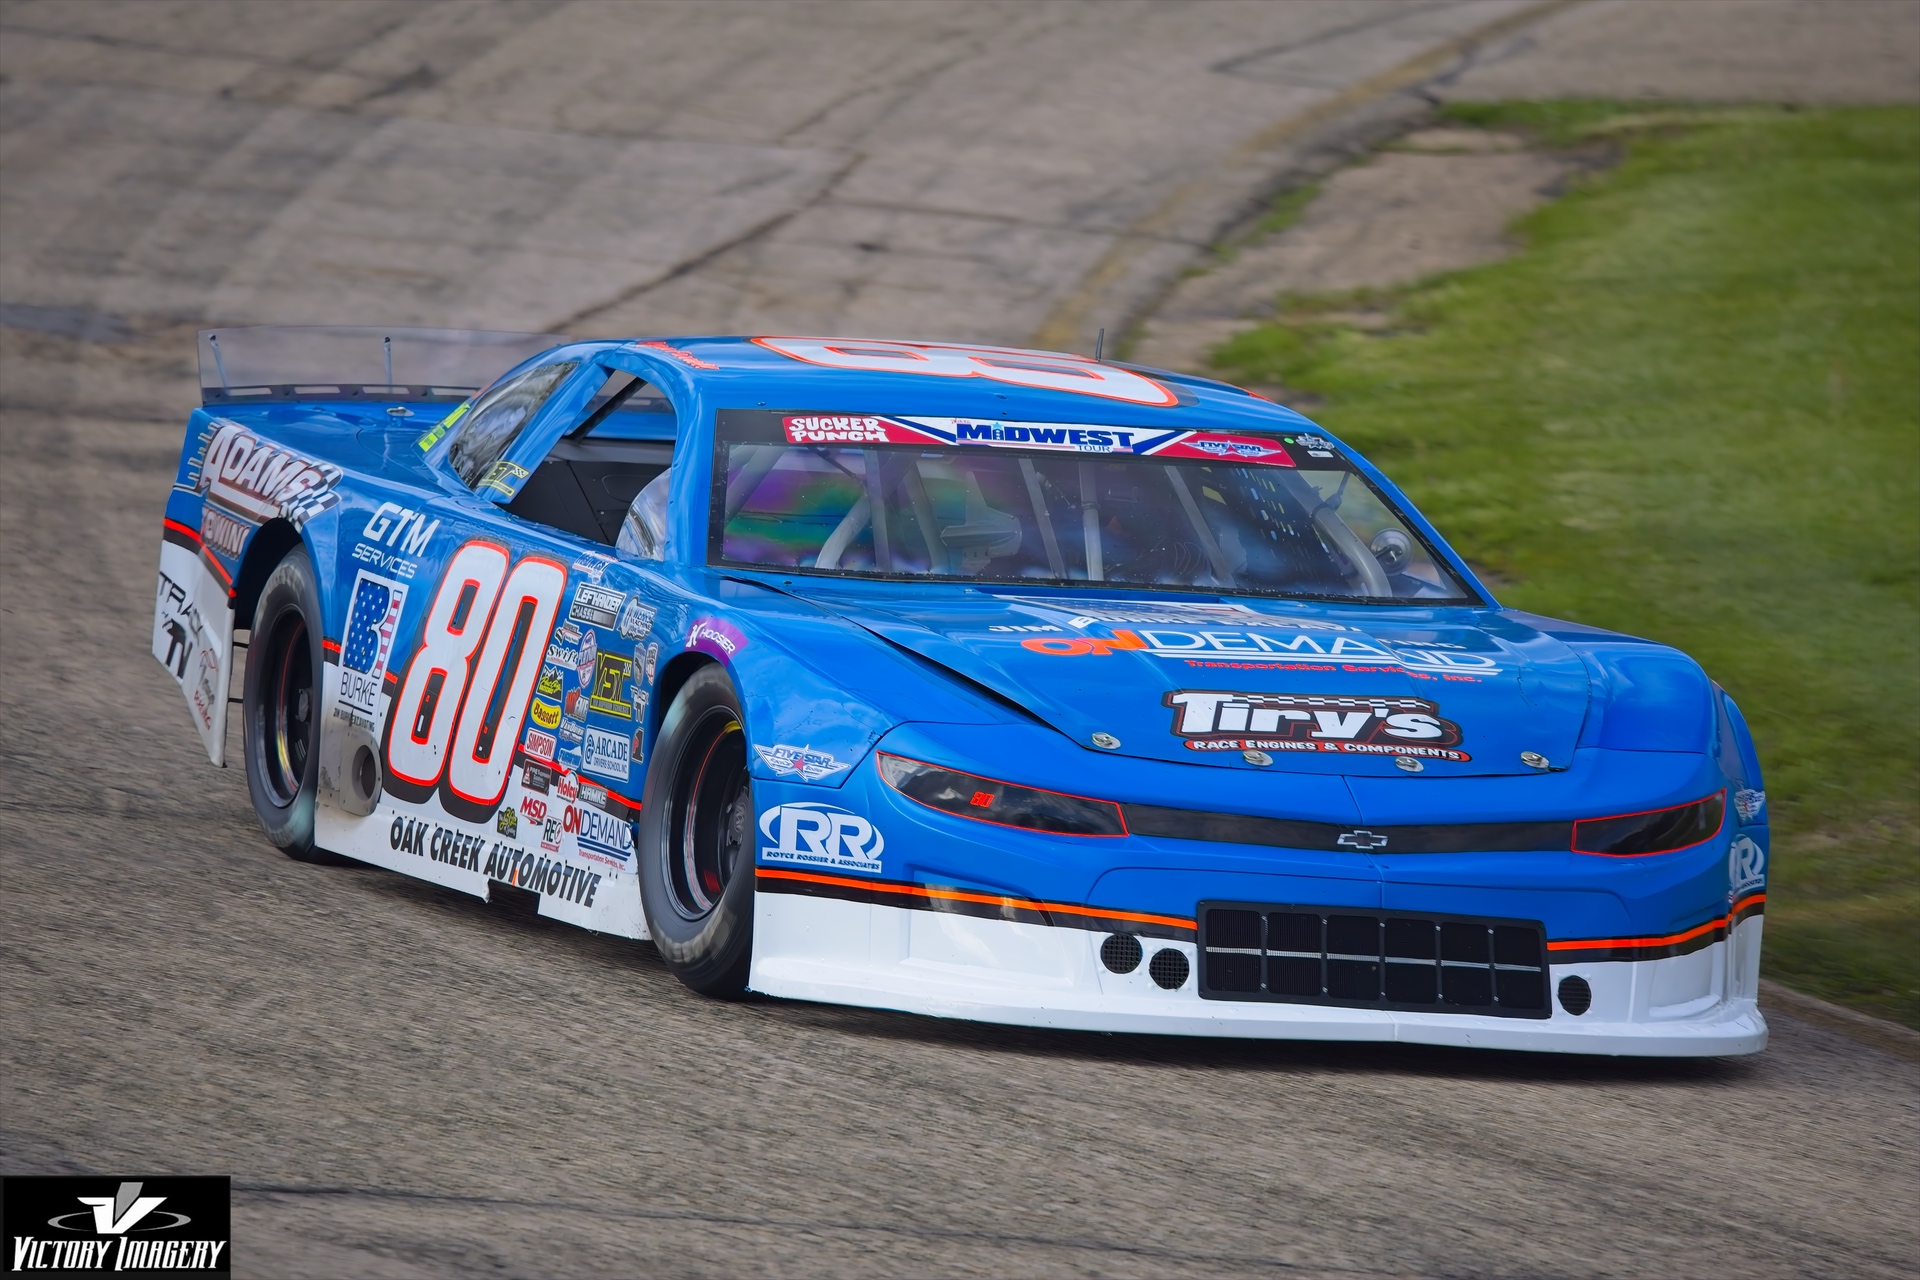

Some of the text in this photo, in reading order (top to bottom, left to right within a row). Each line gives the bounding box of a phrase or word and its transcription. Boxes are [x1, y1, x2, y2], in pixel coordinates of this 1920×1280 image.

[789, 417, 886, 432] SUCKER
[791, 430, 890, 443] PUNCH
[957, 423, 1134, 448] MIDWEST
[1078, 444, 1111, 453] TOUR
[201, 425, 325, 503] ADAMS
[363, 501, 440, 557] GTM
[352, 543, 418, 579] SERVICES
[700, 628, 736, 654] HOOSIER
[1021, 629, 1496, 668] ONDEMAND
[547, 643, 578, 667] Swift
[1184, 660, 1336, 671] Transportation
[388, 538, 568, 807] 80
[341, 671, 378, 707] BURKE
[533, 702, 560, 726] Bassett
[1173, 693, 1443, 738] Tiry's
[526, 732, 554, 757] SIMPSON
[595, 736, 628, 762] ARCADE
[1193, 740, 1461, 759] RACE ENGINES & COMPONENTS
[772, 748, 802, 760] FIVE
[804, 753, 832, 768] STAR
[520, 796, 547, 819] MSD
[580, 784, 607, 806] HAMKE
[563, 805, 632, 851] ONDEMAND
[390, 816, 602, 908] OAK CREEK AUTOMOTIVE
[766, 851, 794, 859] ROYCE
[797, 854, 828, 863] ROSSIER
[838, 859, 880, 870] ASSOCIATES
